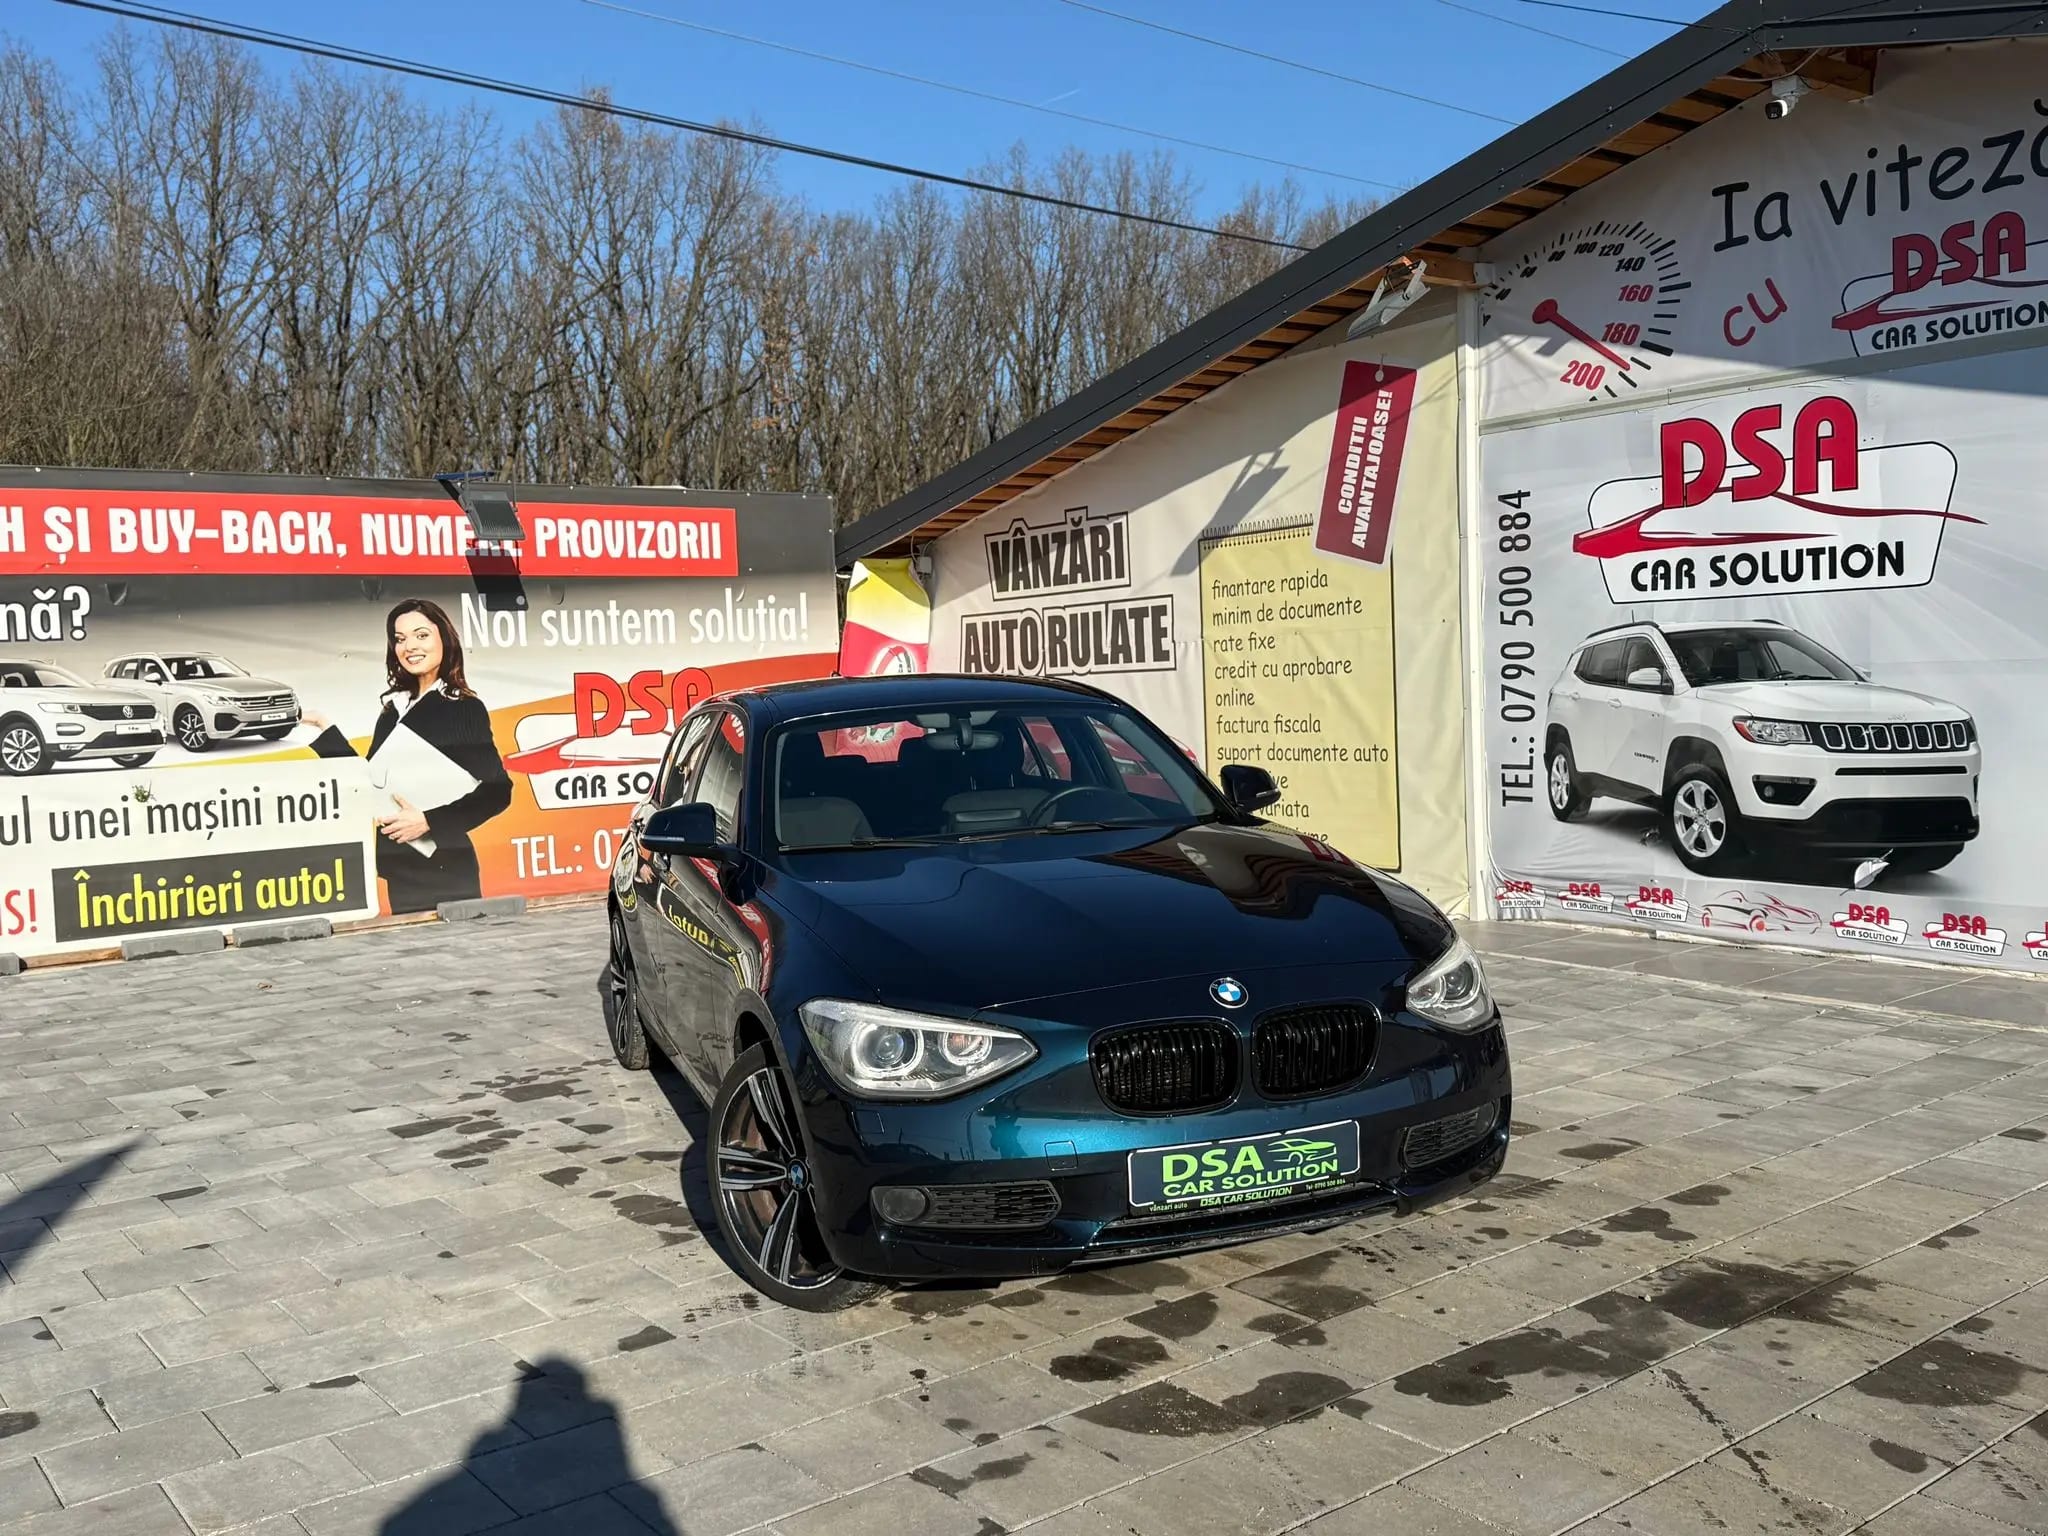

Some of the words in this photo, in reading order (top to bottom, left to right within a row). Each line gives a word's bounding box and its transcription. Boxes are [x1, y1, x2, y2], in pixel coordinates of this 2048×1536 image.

[1712, 181, 1793, 253] Ia
[1573, 241, 1598, 255] 100
[1598, 243, 1625, 257] 120
[1892, 211, 2027, 294] DSA
[1615, 256, 1646, 272] 140
[1617, 284, 1654, 302] 160
[1723, 277, 1788, 346] cu
[1602, 322, 1641, 345] 180
[1871, 323, 1917, 351] CAR
[1560, 360, 1606, 390] 200
[1338, 416, 1368, 514] CONDITII
[1661, 395, 1858, 508] DSA
[1352, 389, 1393, 548] AVANTAJOASE!
[44, 505, 92, 564] ȘI
[108, 507, 348, 558] BUY-BACK,
[534, 516, 723, 560] PROVIZORII
[1498, 490, 1531, 553] 884
[990, 515, 1129, 594] VÂNZĂRI
[1630, 559, 1697, 593] CAR
[1709, 540, 1904, 588] SOLUTION
[1212, 579, 1276, 600] finantare
[1281, 568, 1328, 596] rapida
[1499, 566, 1533, 626] 500
[460, 592, 528, 649] Noi
[540, 598, 677, 646] suntem
[689, 586, 809, 654] soluția!
[1213, 606, 1252, 626] minim
[1257, 603, 1274, 623] de
[1279, 597, 1363, 621] documente
[964, 614, 1042, 673] AUTO
[1048, 604, 1170, 670] RULATE
[1213, 635, 1244, 652] rate
[1248, 631, 1276, 651] fixe
[1215, 660, 1257, 679] credit
[1262, 665, 1278, 678] cu
[1283, 656, 1353, 682] aprobare
[1500, 641, 1535, 722] 0790
[1215, 687, 1255, 707] online
[1216, 714, 1269, 735] factura
[1273, 713, 1321, 735] fiscala
[1217, 743, 1262, 765] suport
[1267, 741, 1349, 762] documente
[1353, 743, 1389, 763] auto
[555, 773, 607, 801] CAR
[618, 770, 654, 797] SO
[1501, 736, 1535, 807] TEL.:
[49, 794, 130, 841] unei
[147, 785, 263, 840] mașini
[277, 779, 341, 824] noi!
[511, 833, 583, 879] TEL.:
[73, 869, 243, 929] Închirieri
[256, 859, 346, 910] auto!
[1639, 886, 1674, 905] DSA
[0, 888, 37, 936] S!
[1649, 910, 1682, 920] SOLUTION
[1848, 903, 1890, 926] DSA
[1943, 913, 1988, 936] DSA
[1841, 928, 1857, 937] CAR
[1858, 930, 1899, 943] SOLUTION
[1935, 939, 1951, 949] CAR
[1953, 941, 1997, 954] SOLUTION
[1162, 1145, 1265, 1183] DSA
[1162, 1179, 1214, 1197] CAR
[1222, 1159, 1338, 1187] SOLUTION
[1174, 1202, 1188, 1210] auto
[1200, 1197, 1222, 1207] DSA
[1223, 1193, 1245, 1204] CAR
[1245, 1186, 1293, 1202] SOLUTION
